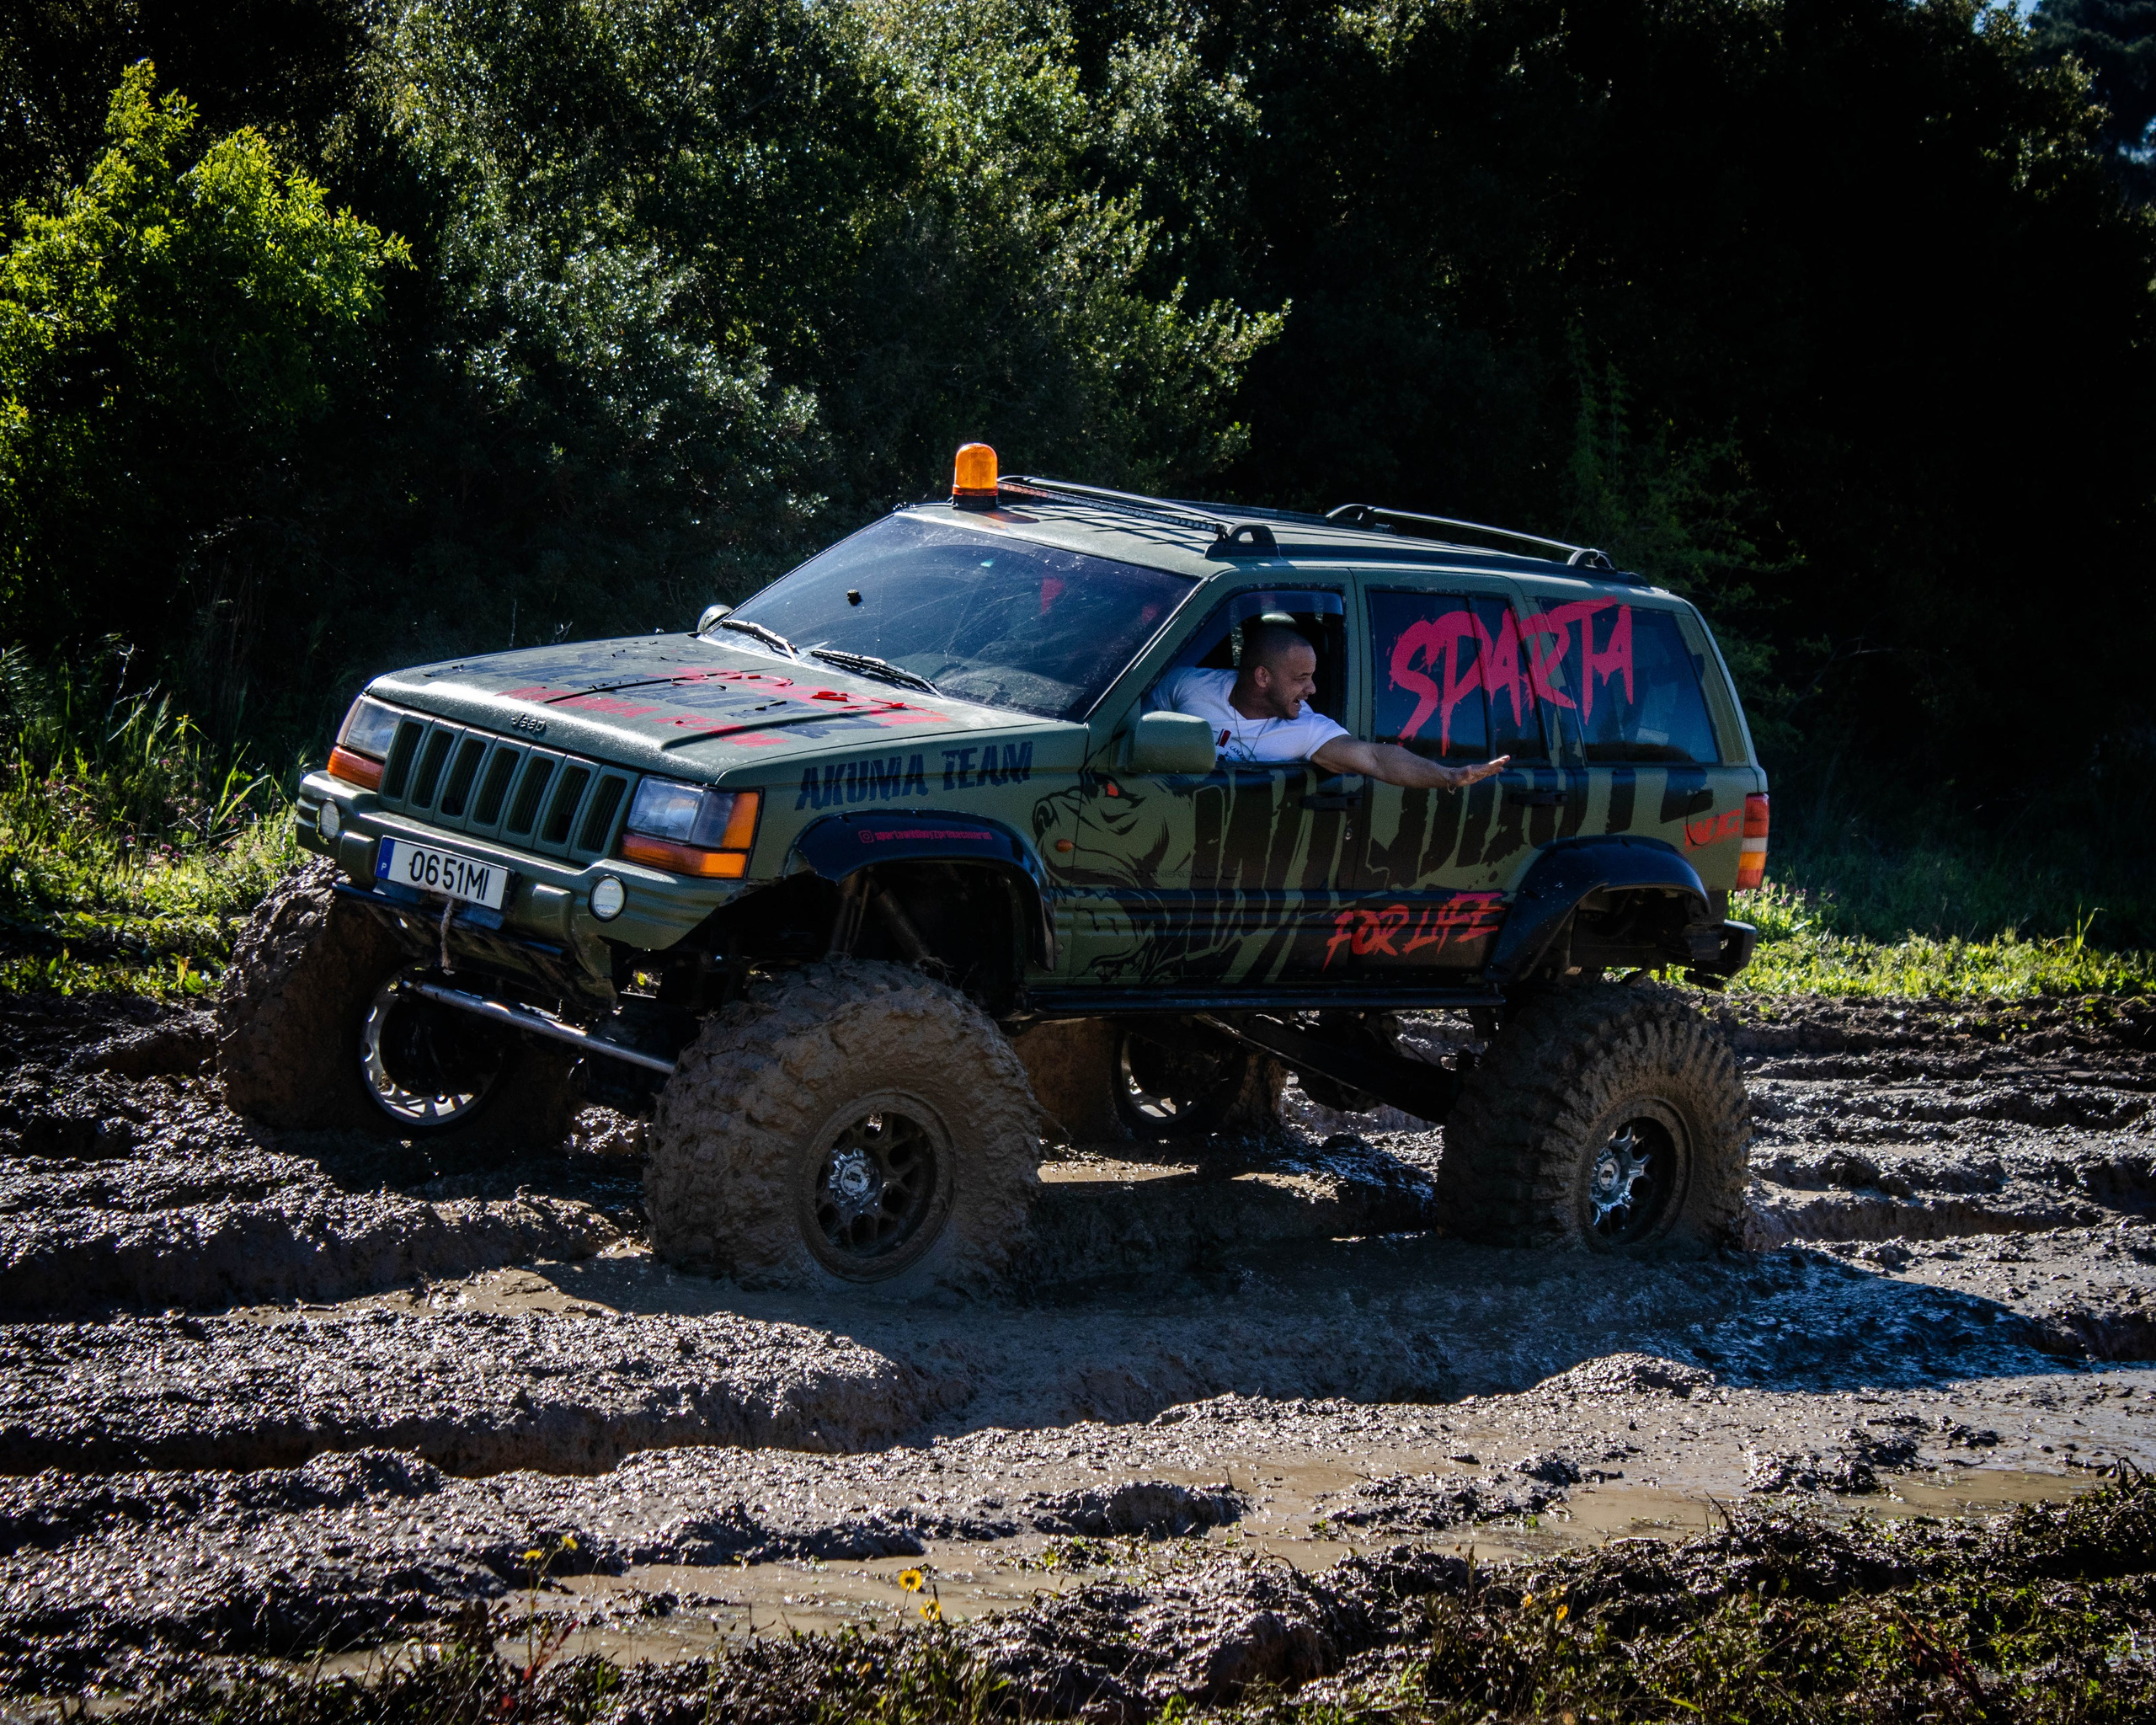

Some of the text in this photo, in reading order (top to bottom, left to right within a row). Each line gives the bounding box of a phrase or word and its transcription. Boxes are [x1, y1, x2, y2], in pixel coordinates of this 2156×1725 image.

[1389, 595, 1635, 756] SPARTA
[510, 713, 546, 734] Jeep
[795, 740, 1033, 811] AKUMA TEAM
[381, 851, 490, 900] P 0651MI
[1322, 892, 1504, 971] FOR LIFE
